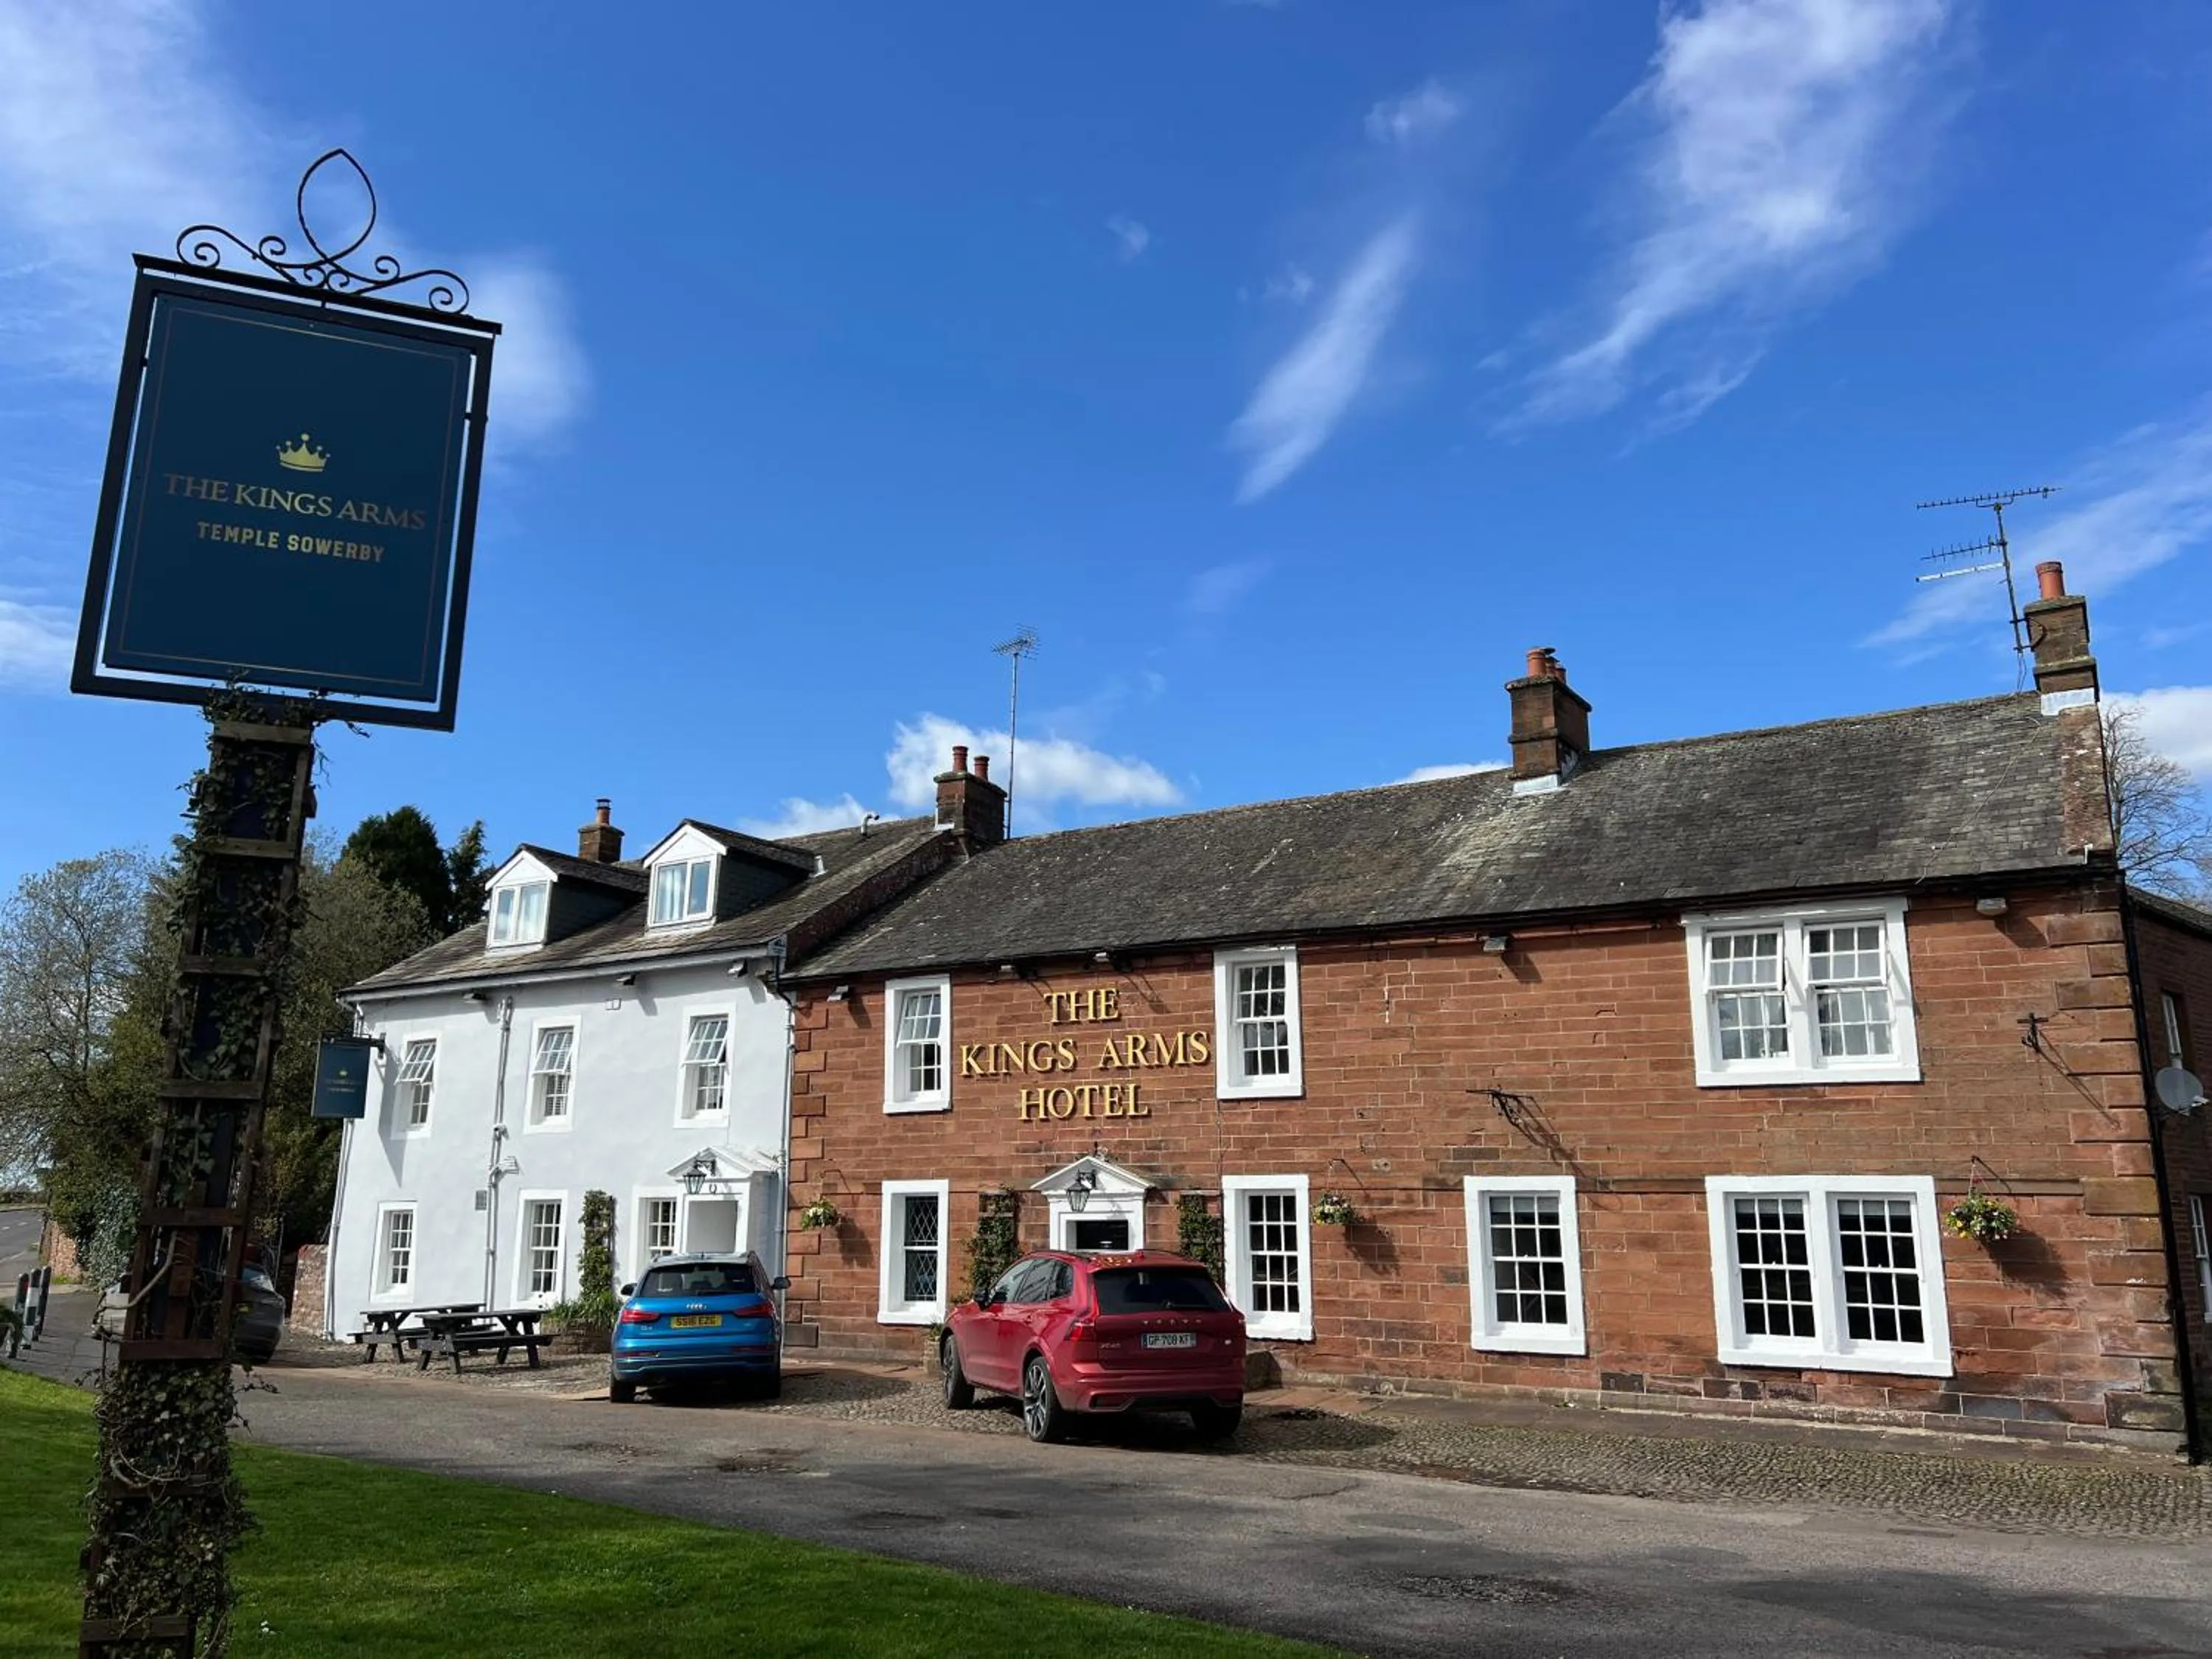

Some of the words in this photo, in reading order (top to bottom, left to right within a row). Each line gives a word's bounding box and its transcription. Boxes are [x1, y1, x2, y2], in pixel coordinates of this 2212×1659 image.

[163, 473, 229, 503] THE
[234, 483, 333, 517] KINGS
[336, 499, 425, 531] ARMS
[197, 521, 280, 549] TEMPLE
[287, 534, 385, 563] SOWERBY
[1043, 988, 1119, 1023] THE
[960, 1038, 1076, 1077] KINGS
[1098, 1032, 1210, 1068] ARMS
[1018, 1084, 1149, 1121] HOTEL
